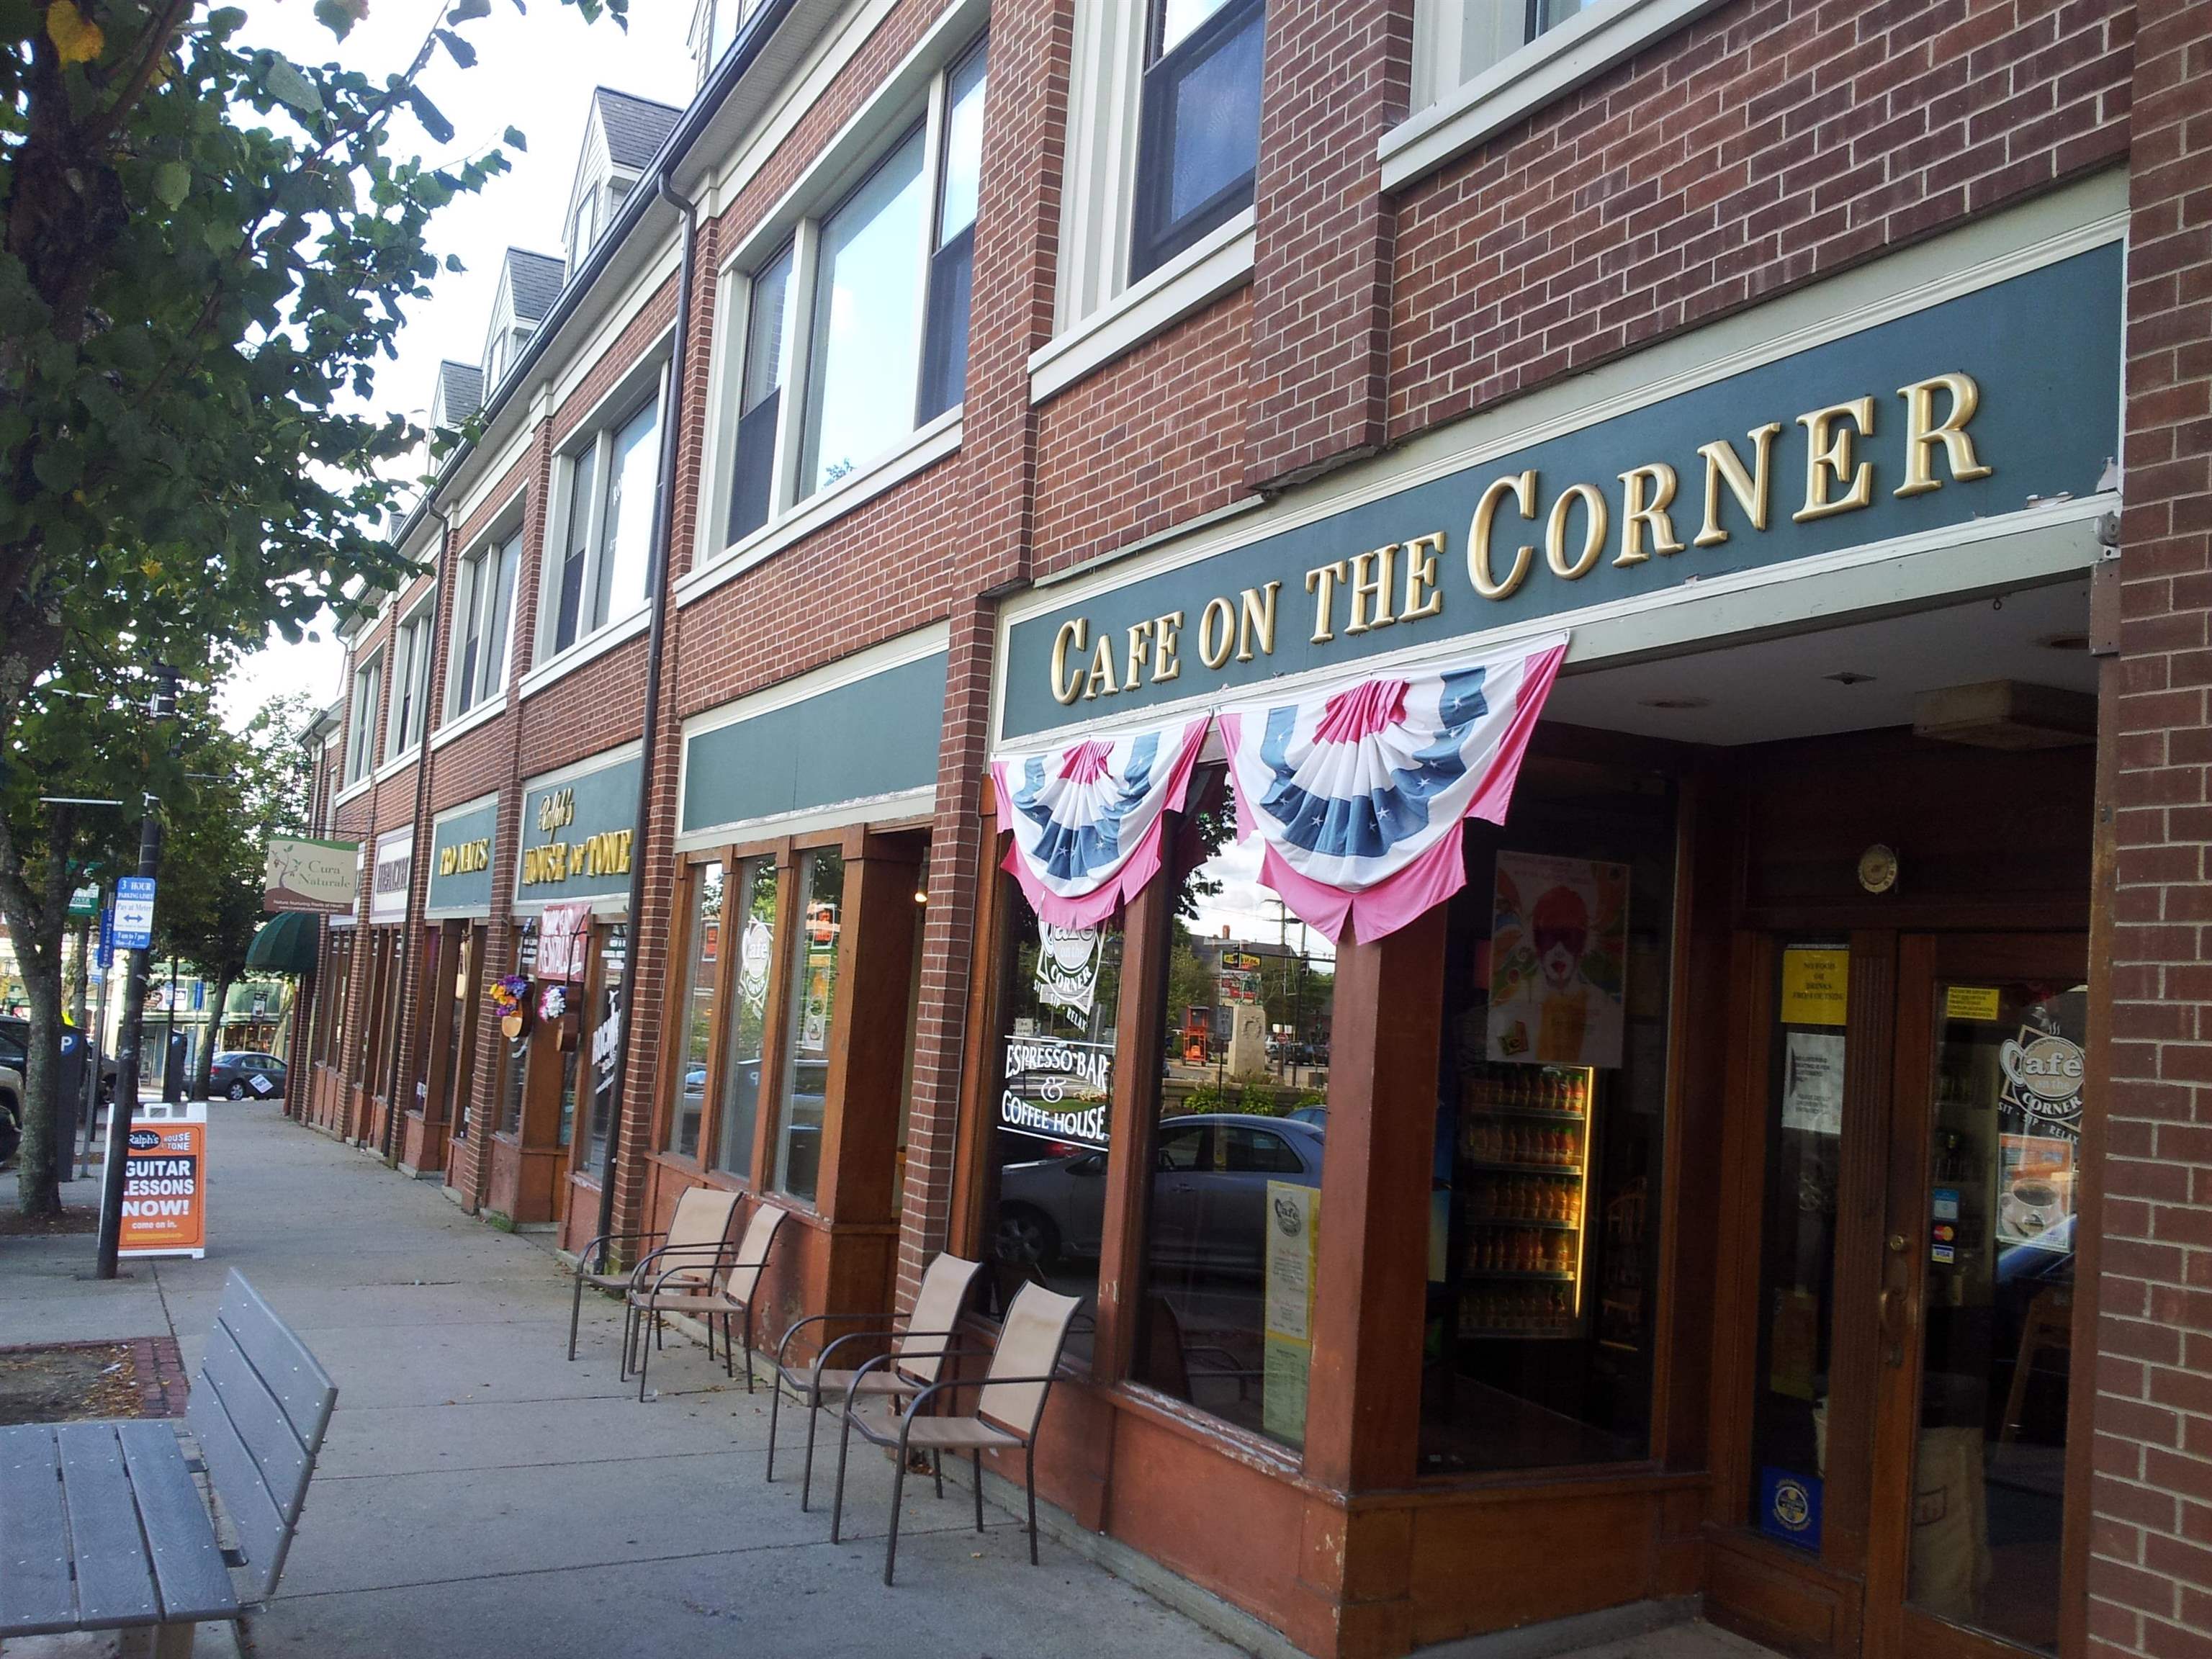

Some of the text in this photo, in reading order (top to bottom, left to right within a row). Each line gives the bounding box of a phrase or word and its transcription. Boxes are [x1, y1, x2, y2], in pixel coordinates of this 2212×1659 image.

[1051, 372, 1992, 705] CAFE ON THE CORNER
[538, 787, 574, 843] Ralph's
[522, 841, 568, 885] HOUSE
[586, 829, 634, 877] TONE
[309, 860, 340, 873] Cura
[121, 880, 151, 891] 3 HOUR
[299, 873, 351, 888] Naturale
[1073, 942, 1084, 958] the
[1051, 963, 1092, 993] CORNER
[1066, 1007, 1089, 1033] RELAX
[1004, 1044, 1107, 1094] ESPRESSO BAR
[1040, 1076, 1066, 1103] &
[2051, 1078, 2069, 1090] the
[2022, 1092, 2082, 1115] CORNER
[1002, 1089, 1106, 1141] COFFEE HOUSE
[1998, 1102, 2013, 1115] SIT
[2049, 1125, 2080, 1146] RELAX
[128, 1133, 160, 1148] Ralph's
[163, 1132, 191, 1142] HOUSE
[167, 1142, 191, 1151] TONE
[125, 1160, 191, 1177] GUITAR
[123, 1179, 194, 1196] ESSONS
[122, 1199, 190, 1217] NOW!
